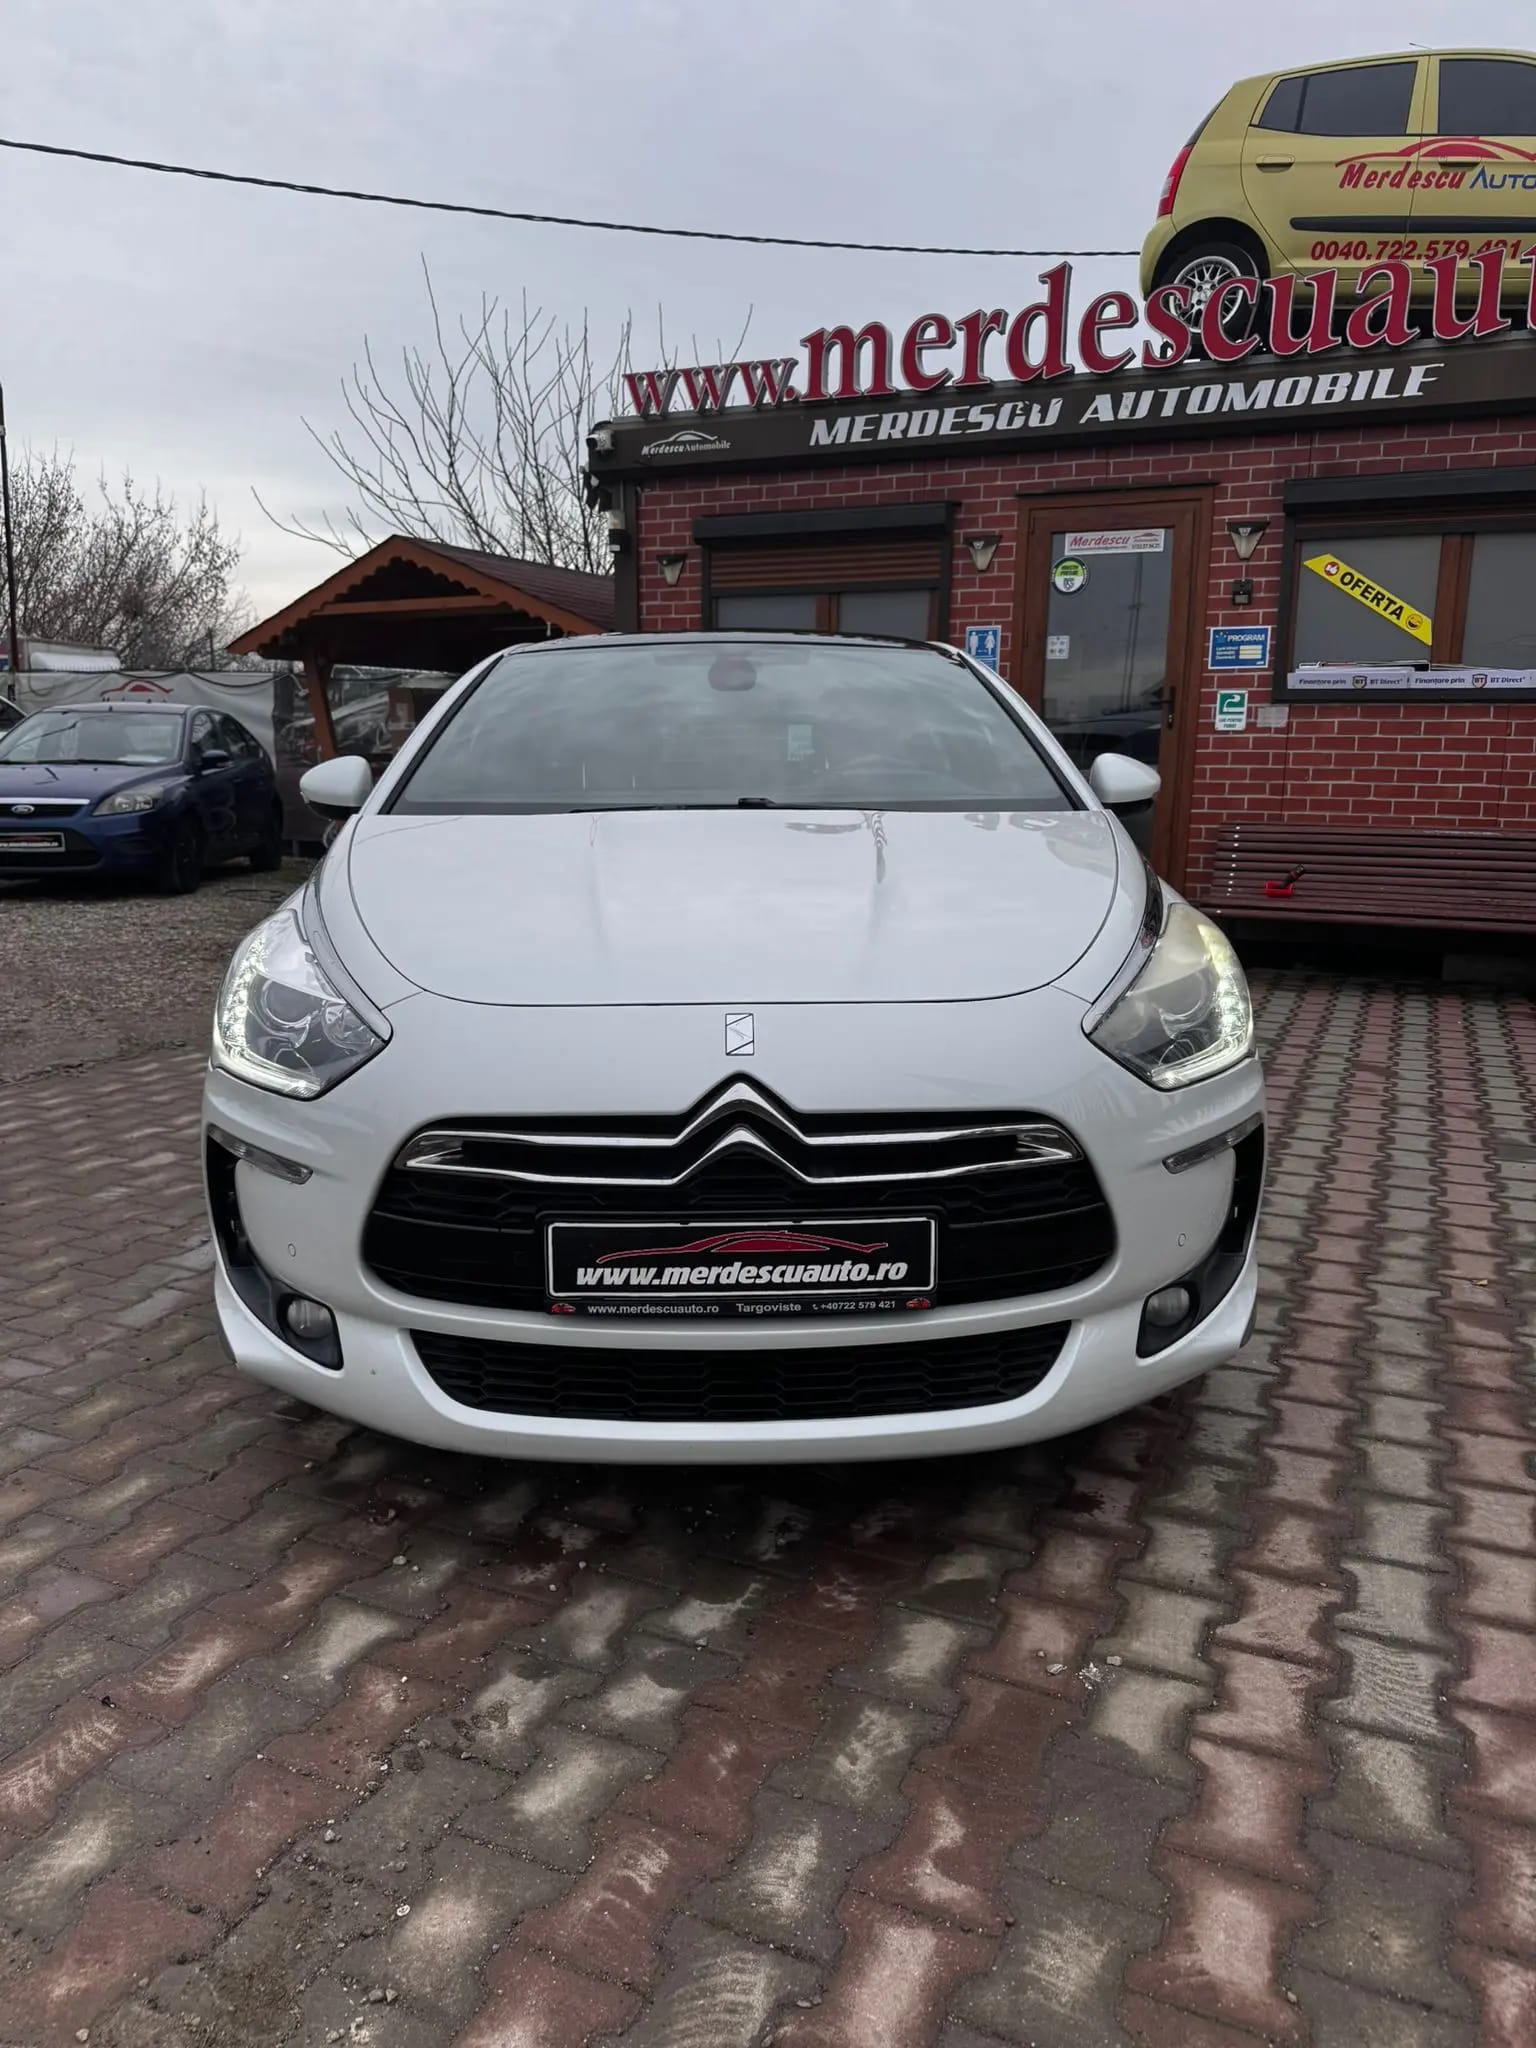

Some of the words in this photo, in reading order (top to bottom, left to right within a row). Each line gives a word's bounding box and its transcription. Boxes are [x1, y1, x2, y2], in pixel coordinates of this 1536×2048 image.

[1339, 161, 1466, 189] Merdescu
[809, 397, 1064, 447] MERDESCU
[1079, 363, 1446, 425] AUTOMOBILE
[1070, 535, 1130, 546] Merdescu
[1339, 571, 1404, 620] OFERTA
[1227, 633, 1265, 642] PROGRAM
[577, 1262, 908, 1285] www.merdescuauto.ro
[588, 1304, 719, 1314] www.merdescuauto.ro
[736, 1303, 801, 1314] Targoviste
[857, 1301, 876, 1310] 579
[879, 1301, 895, 1310] 421
